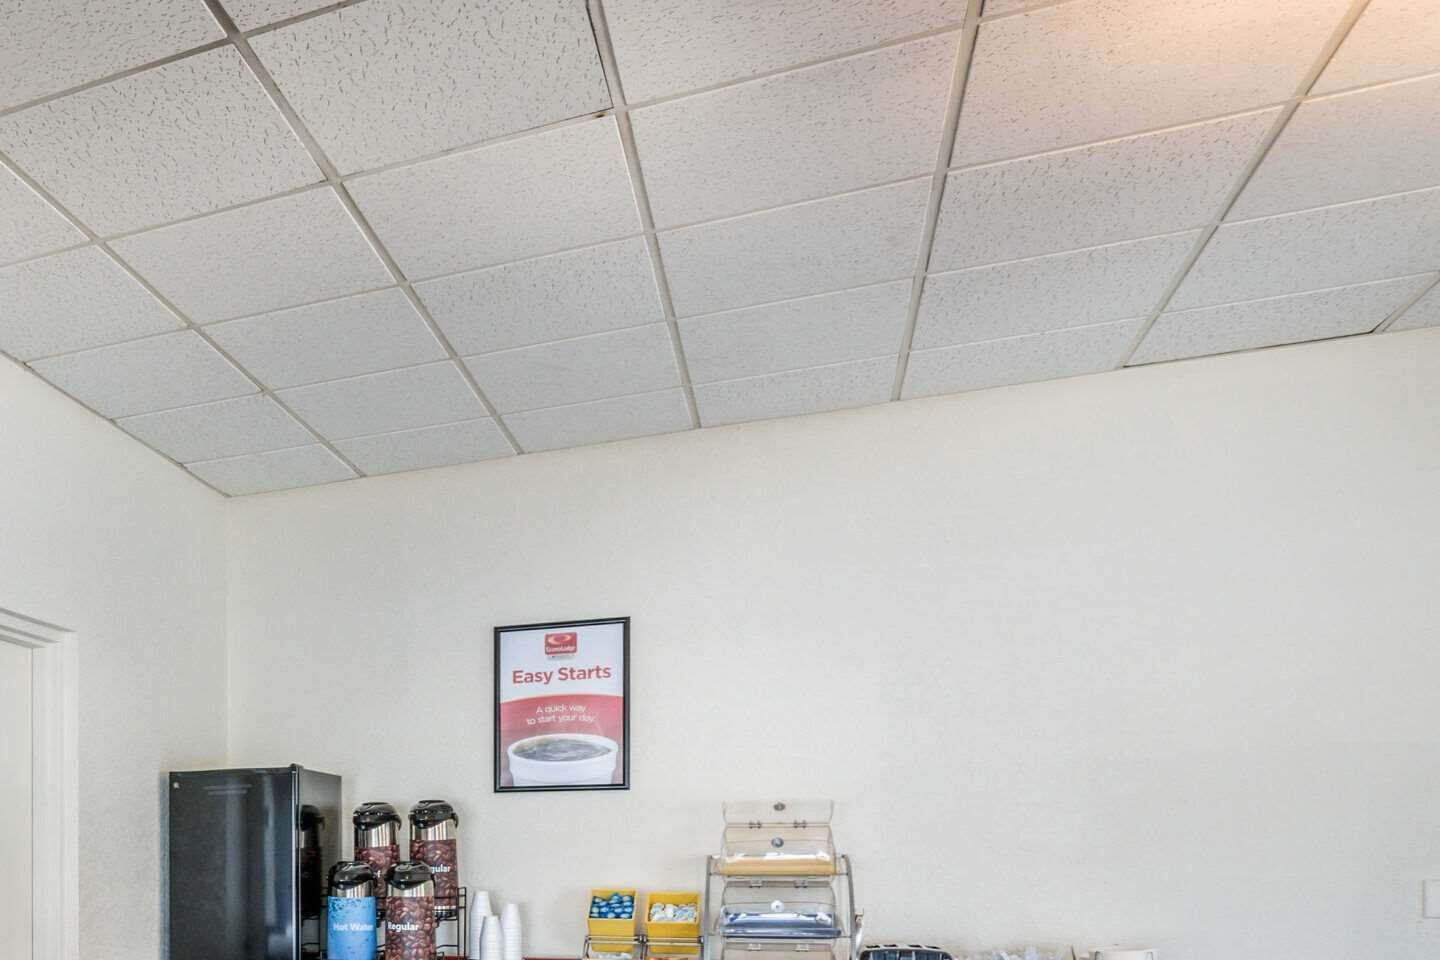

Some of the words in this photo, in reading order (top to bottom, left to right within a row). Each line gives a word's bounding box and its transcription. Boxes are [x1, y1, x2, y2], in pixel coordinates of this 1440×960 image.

[512, 669, 553, 684] Easy
[558, 665, 611, 681] Starts
[536, 705, 543, 713] A
[545, 703, 567, 713] quick
[569, 704, 586, 713] way
[526, 717, 536, 725] to
[538, 714, 556, 723] start
[558, 713, 576, 723] your
[430, 864, 451, 874] gular
[333, 922, 348, 931] Hot
[350, 922, 374, 931] Water
[387, 920, 418, 932] Regular
